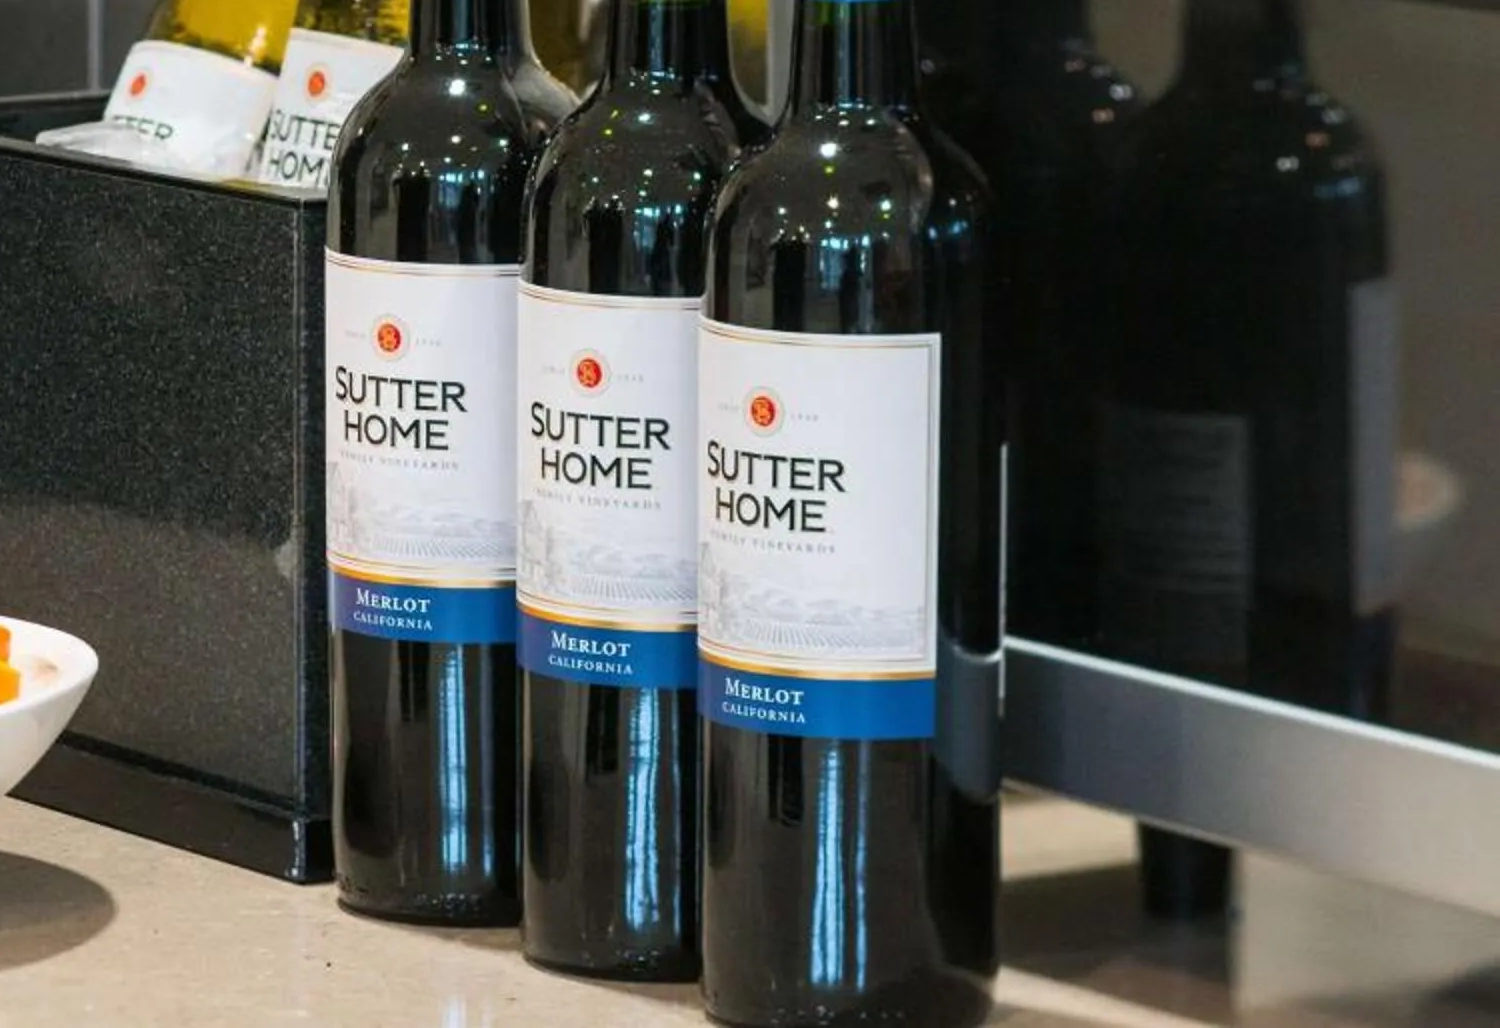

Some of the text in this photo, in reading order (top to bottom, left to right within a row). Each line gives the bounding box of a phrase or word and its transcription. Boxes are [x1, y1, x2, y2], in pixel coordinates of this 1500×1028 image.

[270, 108, 341, 151] SUTTE
[335, 365, 468, 413] SUTTER
[344, 410, 449, 450] HOME
[531, 401, 671, 450] SUTTER
[541, 447, 652, 489] HOME
[707, 440, 846, 492] SUTTER
[715, 487, 826, 532] HOME
[356, 588, 431, 613] MERLOT
[353, 610, 433, 632] CALIFORNIA
[550, 630, 631, 657] MERLOT
[547, 653, 634, 675] CALIFORNIA
[725, 677, 805, 705] MERLOT
[722, 701, 806, 724] CALIFORNIA
